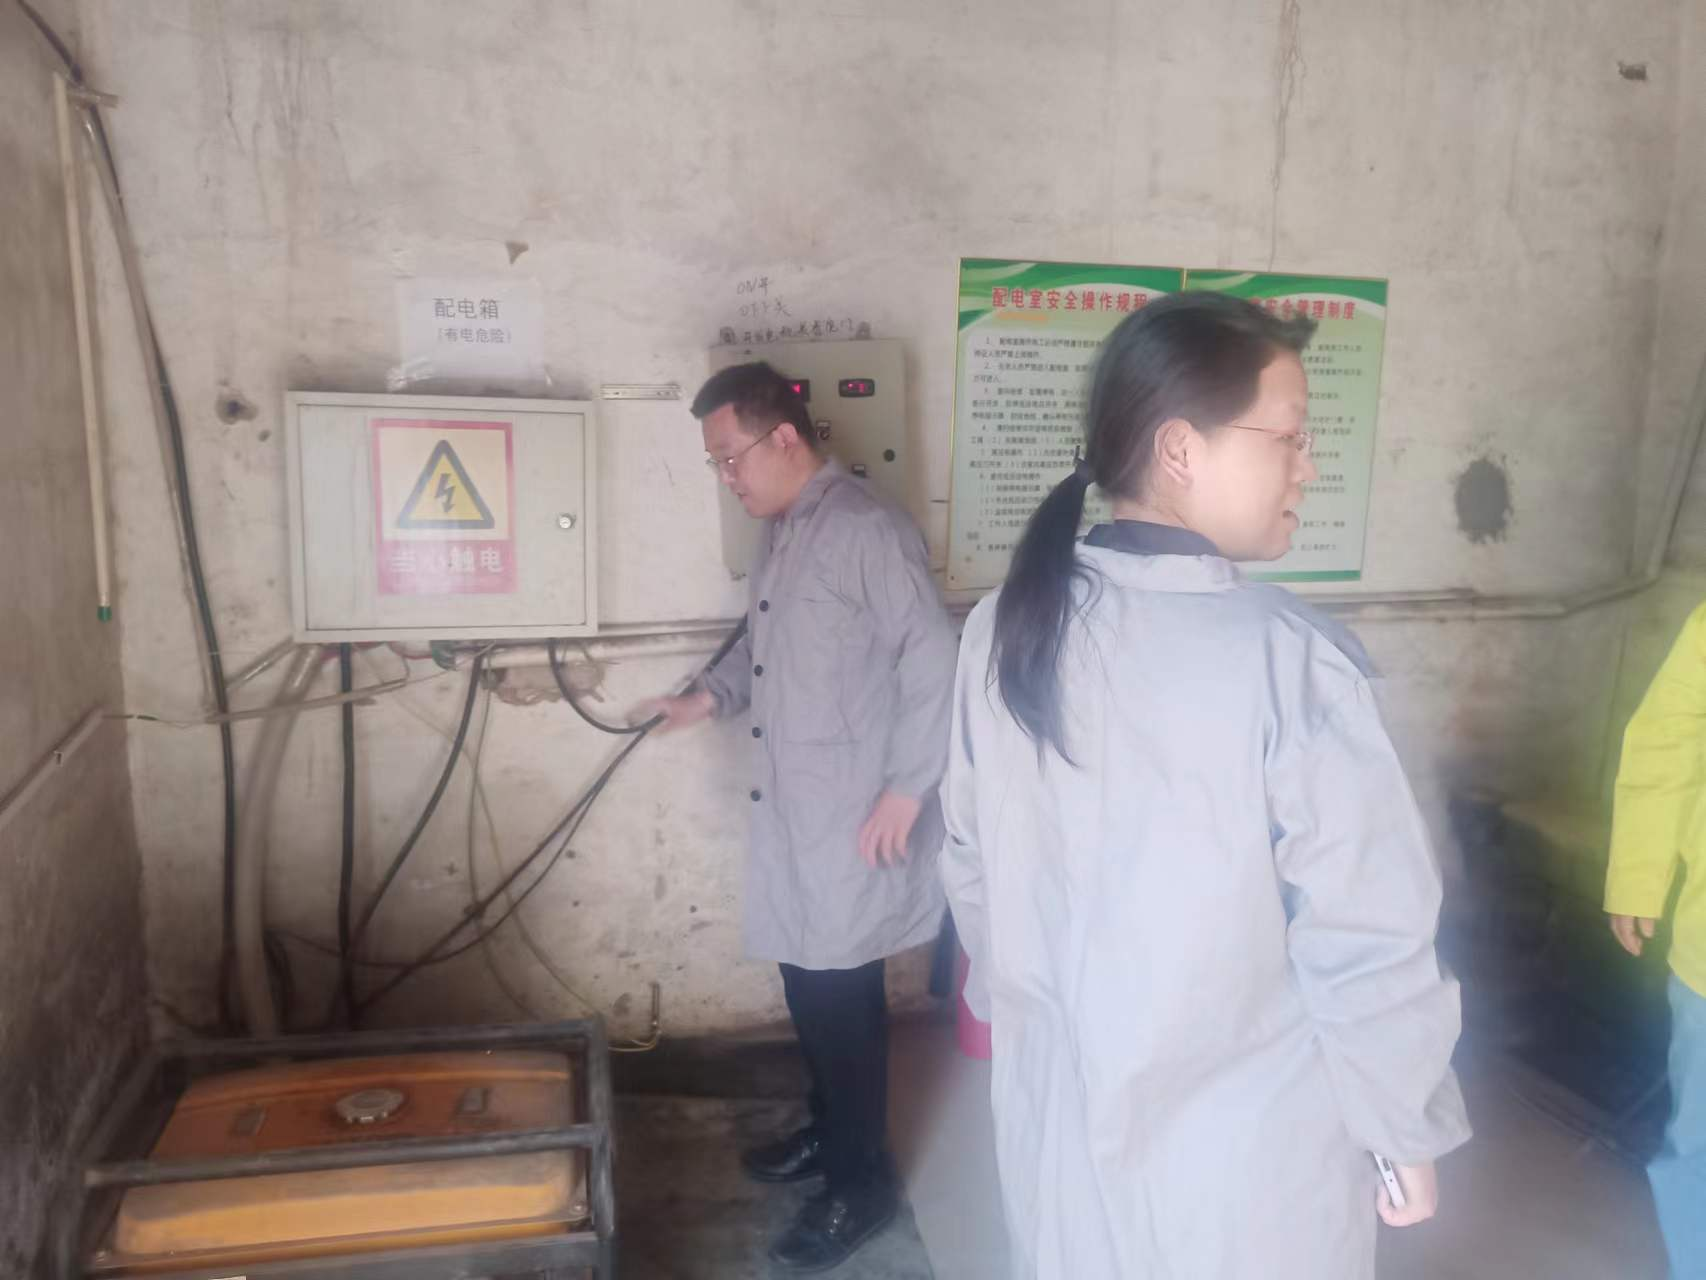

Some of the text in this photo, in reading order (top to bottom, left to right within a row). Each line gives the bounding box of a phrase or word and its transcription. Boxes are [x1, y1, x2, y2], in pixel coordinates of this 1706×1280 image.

[433, 297, 499, 320] 配电箱
[391, 545, 505, 574] 当心触电
